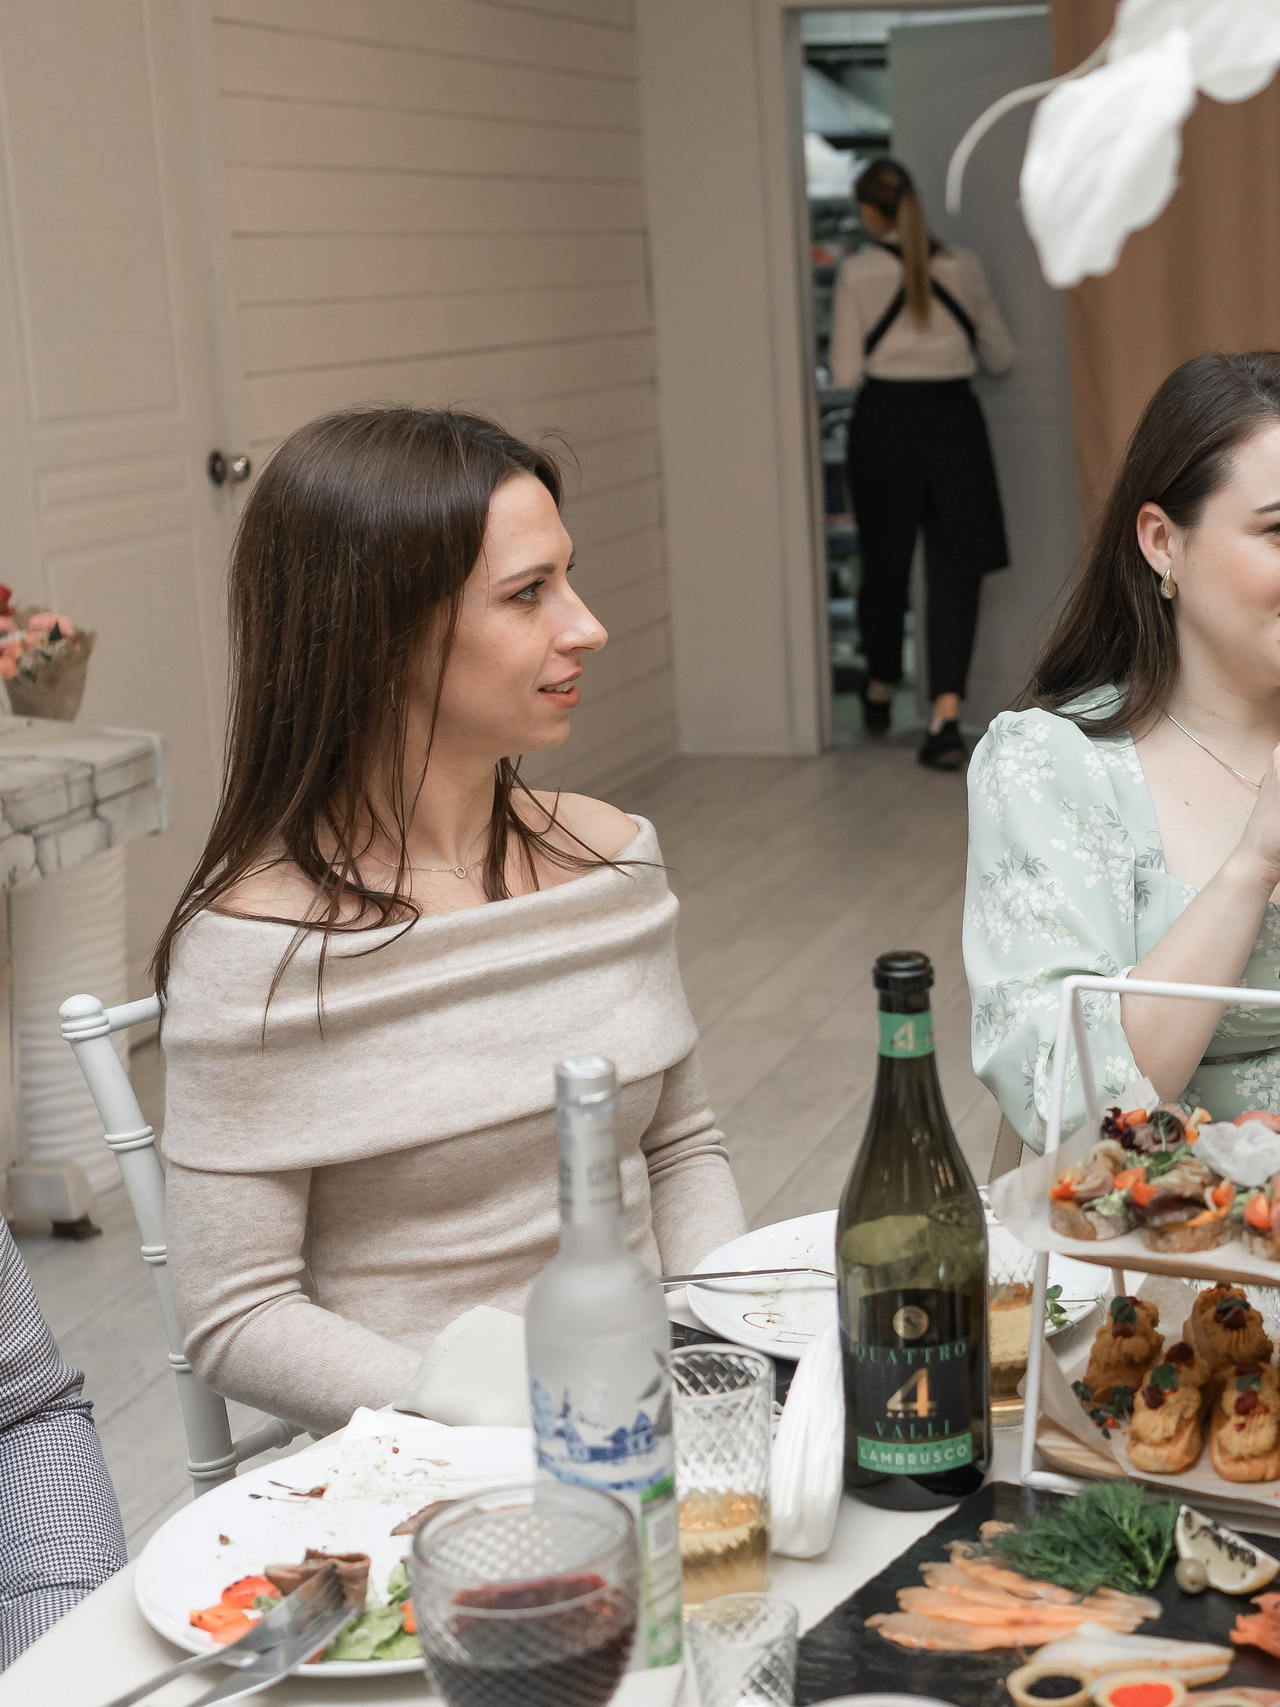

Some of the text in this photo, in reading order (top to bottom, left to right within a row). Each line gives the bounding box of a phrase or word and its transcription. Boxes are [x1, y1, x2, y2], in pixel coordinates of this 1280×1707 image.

[889, 1020, 916, 1051] 4
[854, 1341, 967, 1366] QUATTRO
[886, 1367, 938, 1418] 4
[874, 1419, 950, 1440] VALLI
[860, 1443, 968, 1465] LAMBRUSCO
